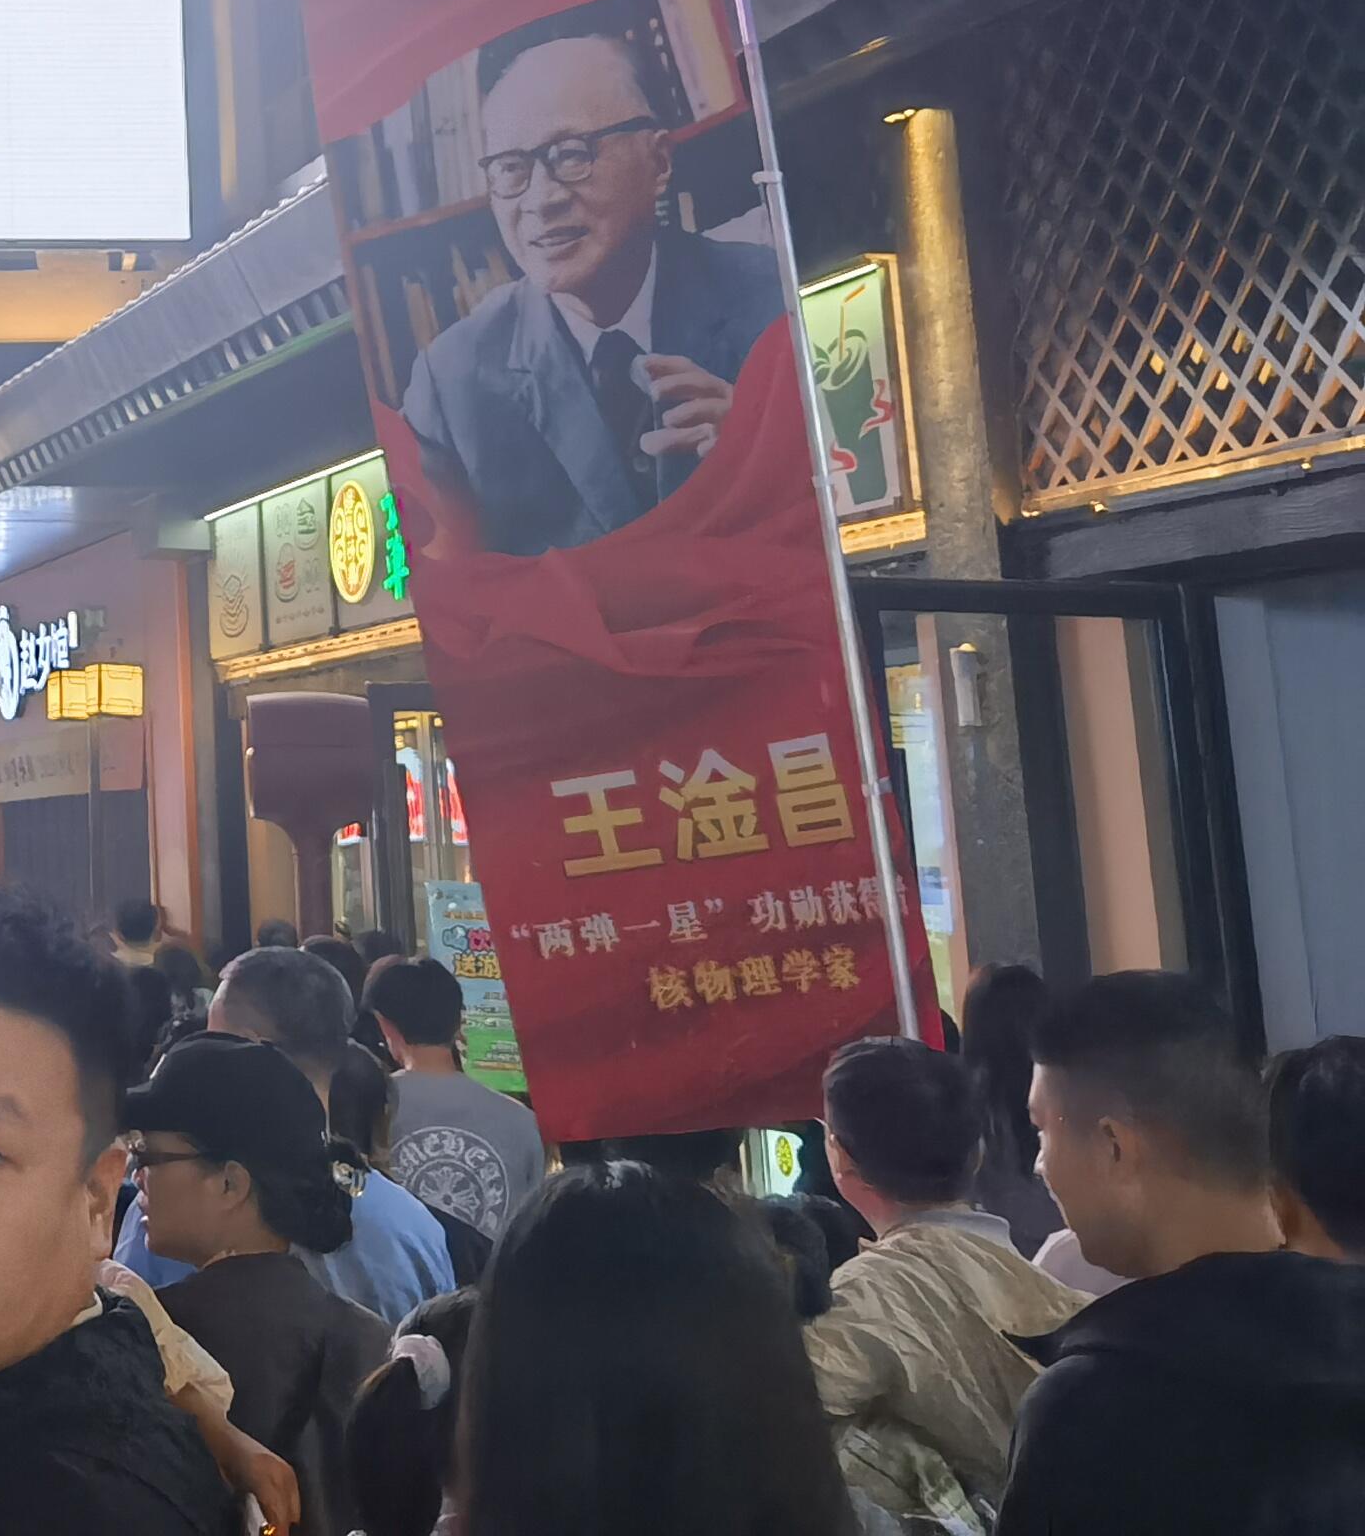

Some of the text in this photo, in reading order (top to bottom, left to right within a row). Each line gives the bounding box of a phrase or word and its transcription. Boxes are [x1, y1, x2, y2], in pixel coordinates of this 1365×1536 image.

[550, 733, 855, 878] 王淦昌
[646, 944, 860, 1013] 核物理学家
